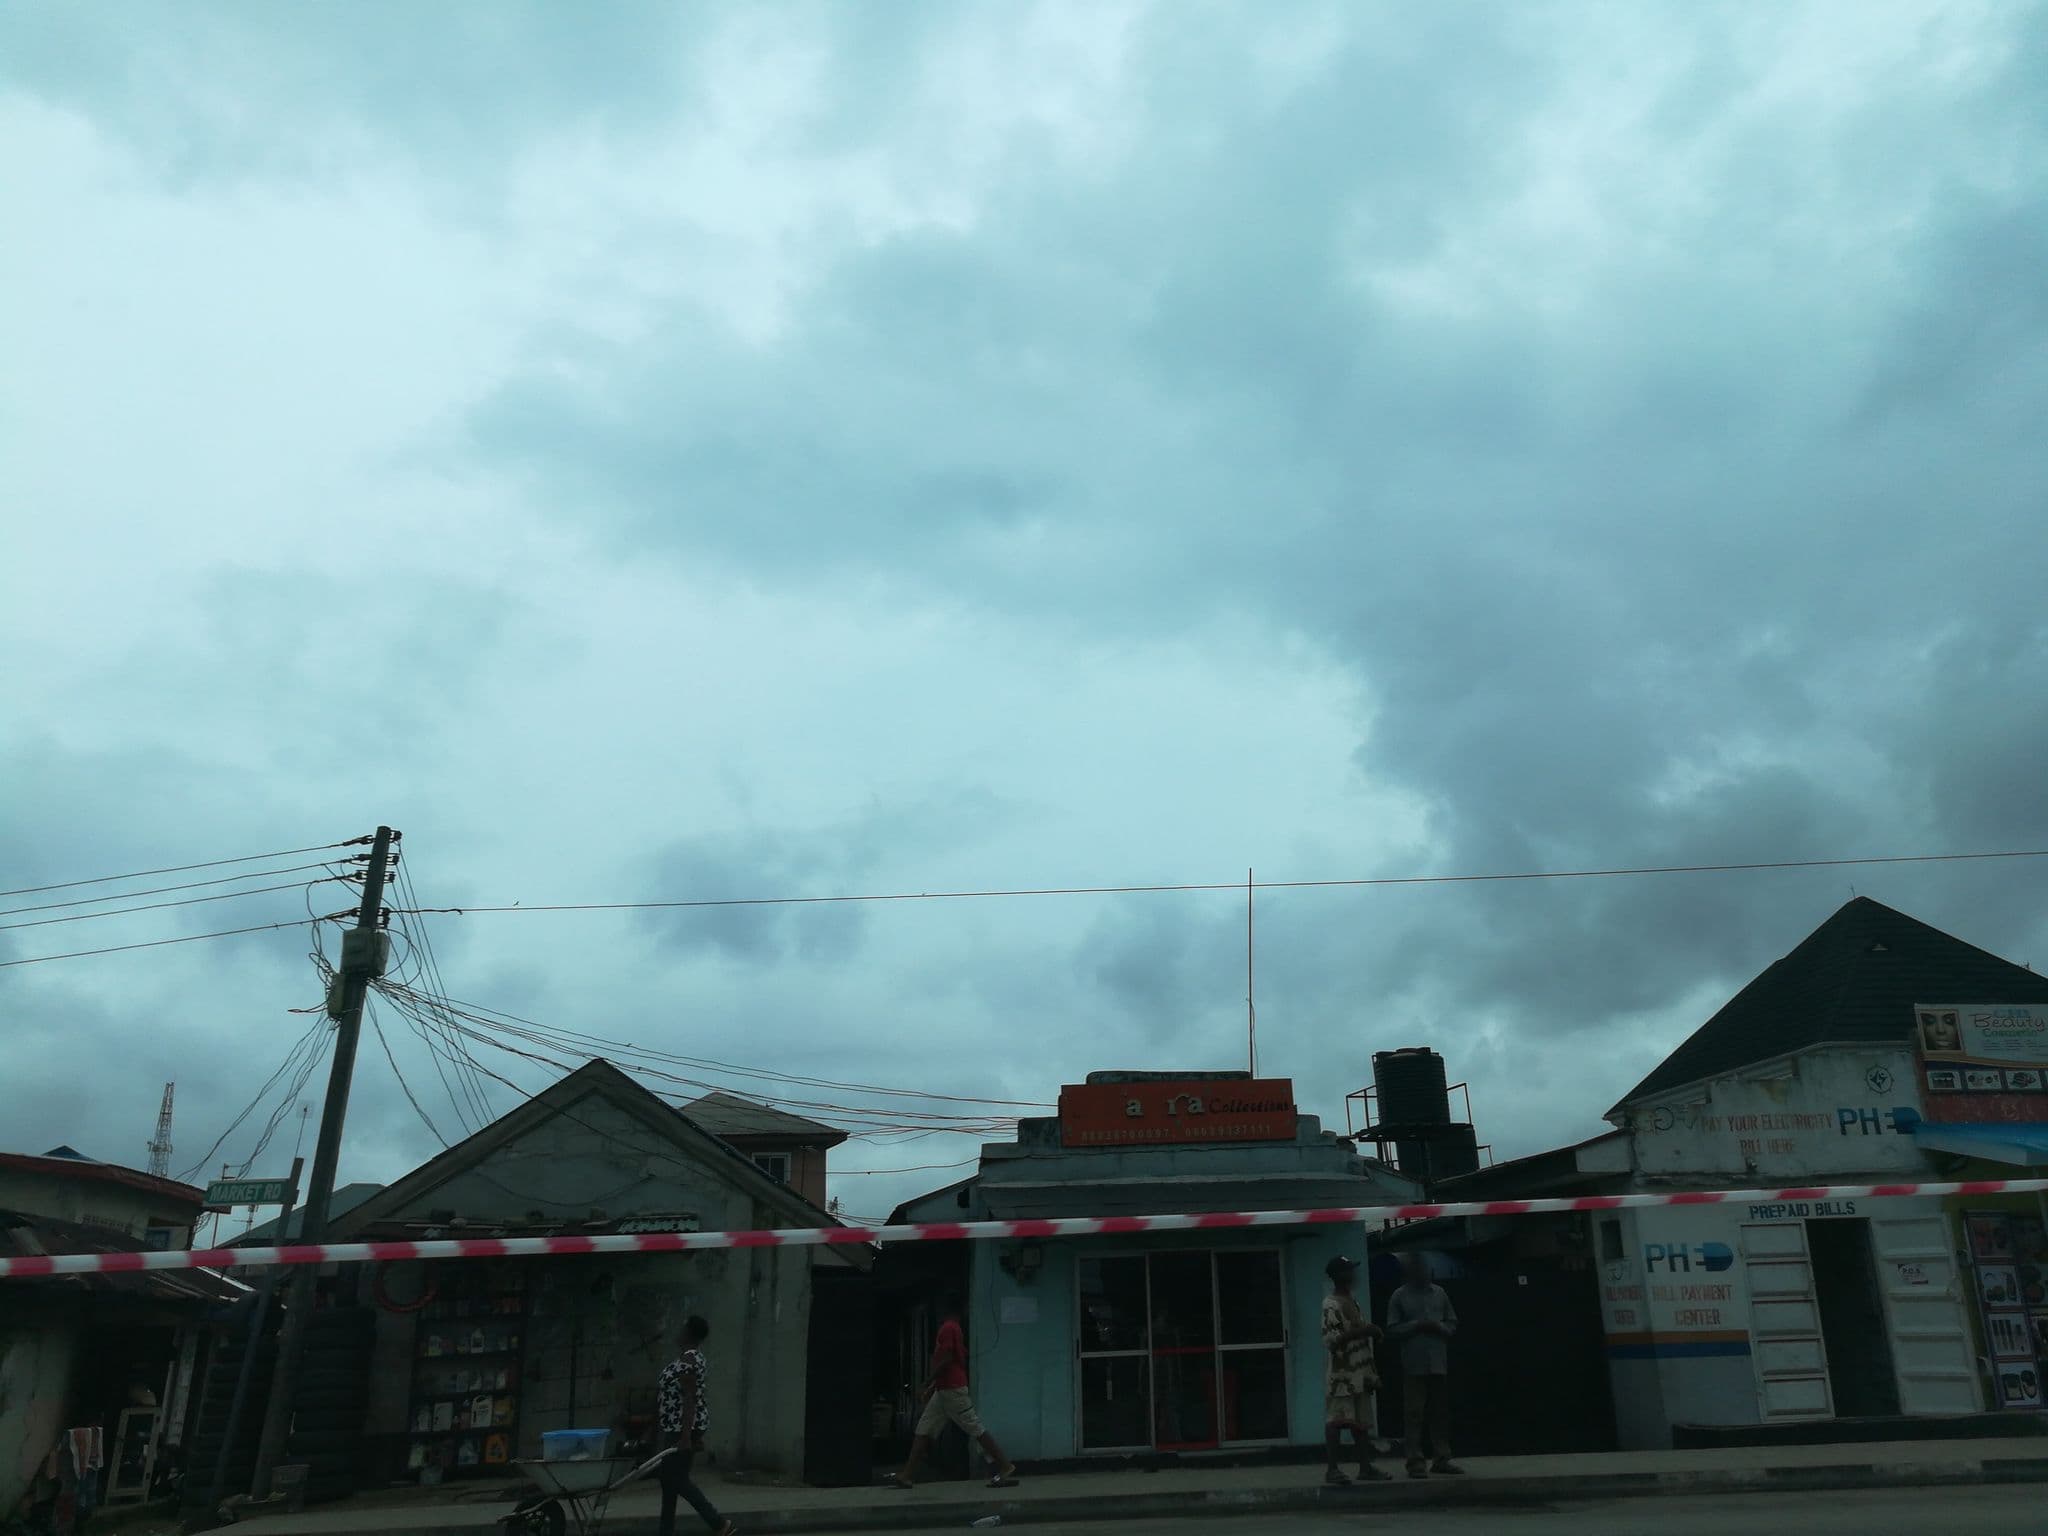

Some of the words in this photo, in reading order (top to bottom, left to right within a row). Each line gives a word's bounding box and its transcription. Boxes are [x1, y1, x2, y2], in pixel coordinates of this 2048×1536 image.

[1968, 1014, 2045, 1032] Beauty
[1728, 1114, 1758, 1131] YOUR
[210, 1184, 261, 1201] MARKET
[263, 1183, 282, 1200] RD
[1748, 1203, 1810, 1219] PREPAID
[1815, 1201, 1856, 1216] BILLS
[1680, 1284, 1732, 1301] PAYMENT
[1675, 1308, 1721, 1325] CENTER
